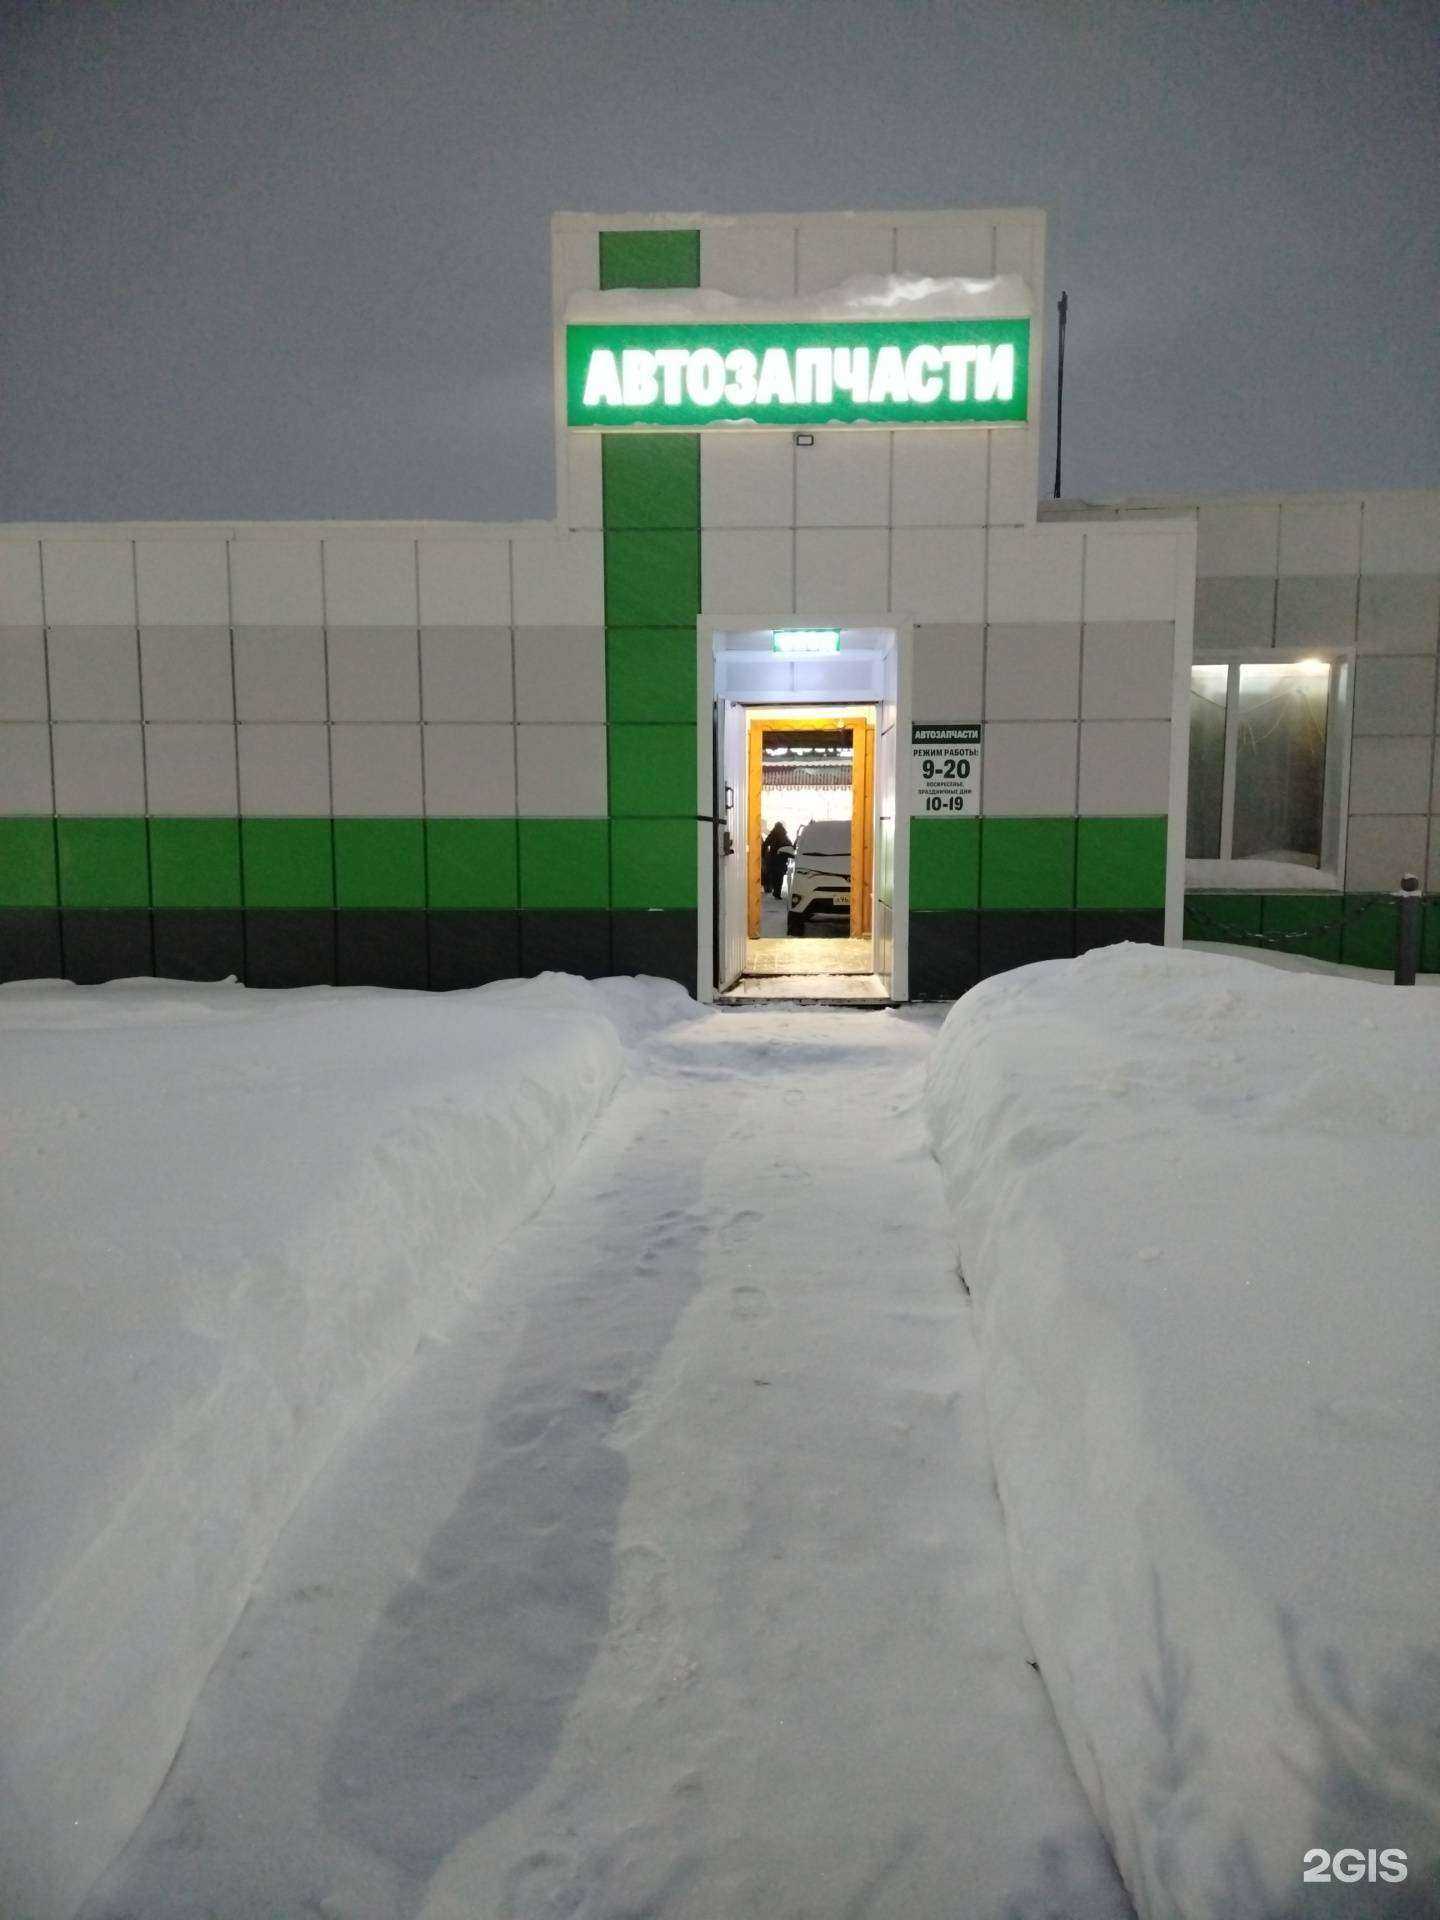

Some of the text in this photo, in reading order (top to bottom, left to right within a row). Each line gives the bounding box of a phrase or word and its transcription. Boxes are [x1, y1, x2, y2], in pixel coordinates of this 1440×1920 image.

[582, 343, 1015, 407] АВТОЗАПЧАСТИ
[915, 730, 978, 739] АВТОЗАПЧАСТИ
[913, 749, 943, 757] РЕЖИМ
[922, 759, 971, 779] 9-20
[926, 796, 964, 811] 10-19
